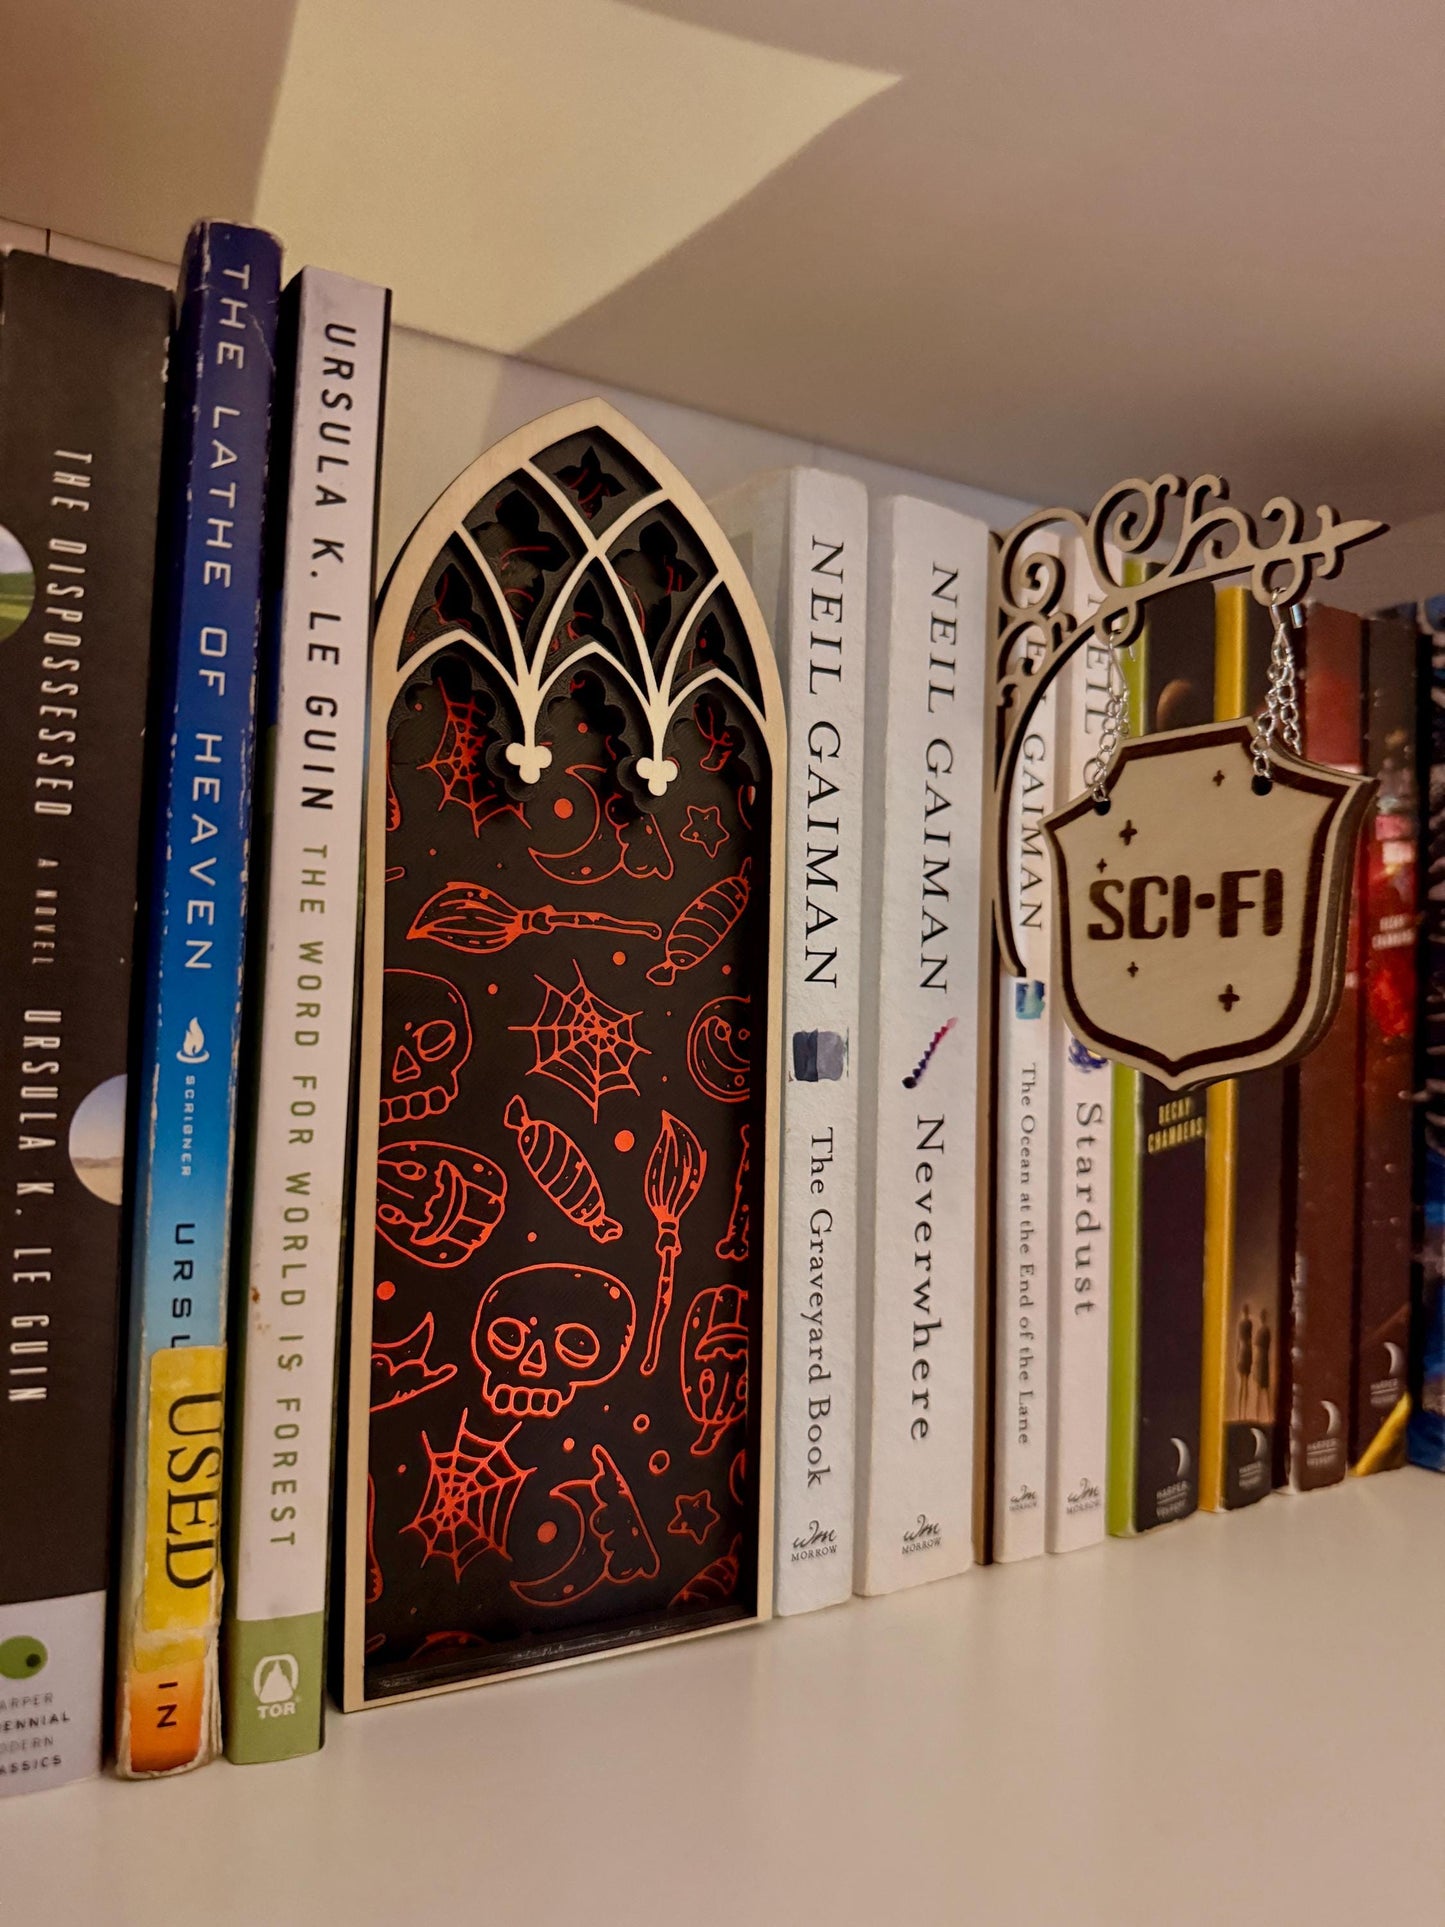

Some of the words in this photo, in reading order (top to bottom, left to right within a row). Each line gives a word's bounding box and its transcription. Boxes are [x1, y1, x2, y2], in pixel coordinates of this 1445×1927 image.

[216, 264, 250, 370] THE
[315, 323, 357, 508] URSULA
[51, 449, 93, 513] THE
[203, 404, 241, 589] LATHE
[310, 537, 345, 579] K.
[307, 611, 341, 666] LE
[809, 534, 845, 696] NEIL
[927, 561, 960, 714] NEIL
[35, 538, 88, 817] DISPOSSESSED
[198, 626, 228, 696] OF
[1084, 594, 1111, 735] EIL
[301, 696, 338, 811] GUIN
[37, 858, 59, 868] A
[184, 732, 223, 970] HEAVEN
[804, 720, 842, 989] GAIMAN
[919, 737, 954, 995] GAIMAN
[1019, 733, 1046, 930] GAIMAN
[300, 845, 328, 914] THE
[32, 889, 58, 965] NOVEL
[295, 941, 324, 1047] WORD
[18, 1009, 62, 1151] URSULA
[288, 1075, 317, 1145] FOR
[1021, 1062, 1037, 1107] The
[181, 1075, 196, 1177] SCRIBNER
[811, 1126, 835, 1196] The
[1020, 1114, 1036, 1185] Ocean
[15, 1182, 54, 1216] K.
[281, 1172, 312, 1307] WORLD
[1019, 1219, 1035, 1254] the
[1020, 1191, 1032, 1212] at
[1074, 1102, 1104, 1316] Stardust
[13, 1248, 52, 1283] LE
[801, 1208, 834, 1385] Graveyard
[910, 1114, 945, 1442] Neverwhere
[1019, 1263, 1035, 1308] End
[8, 1315, 50, 1402] GUIN
[278, 1335, 304, 1371] IS
[1018, 1346, 1034, 1381] the
[1019, 1316, 1034, 1341] of
[807, 1395, 832, 1489] Book
[1018, 1390, 1034, 1445] Lane
[165, 1391, 224, 1588] USED
[270, 1398, 301, 1547] FOREST
[791, 1544, 838, 1562] MORROW
[902, 1537, 941, 1555] MORROW
[257, 1701, 297, 1720] TOR
